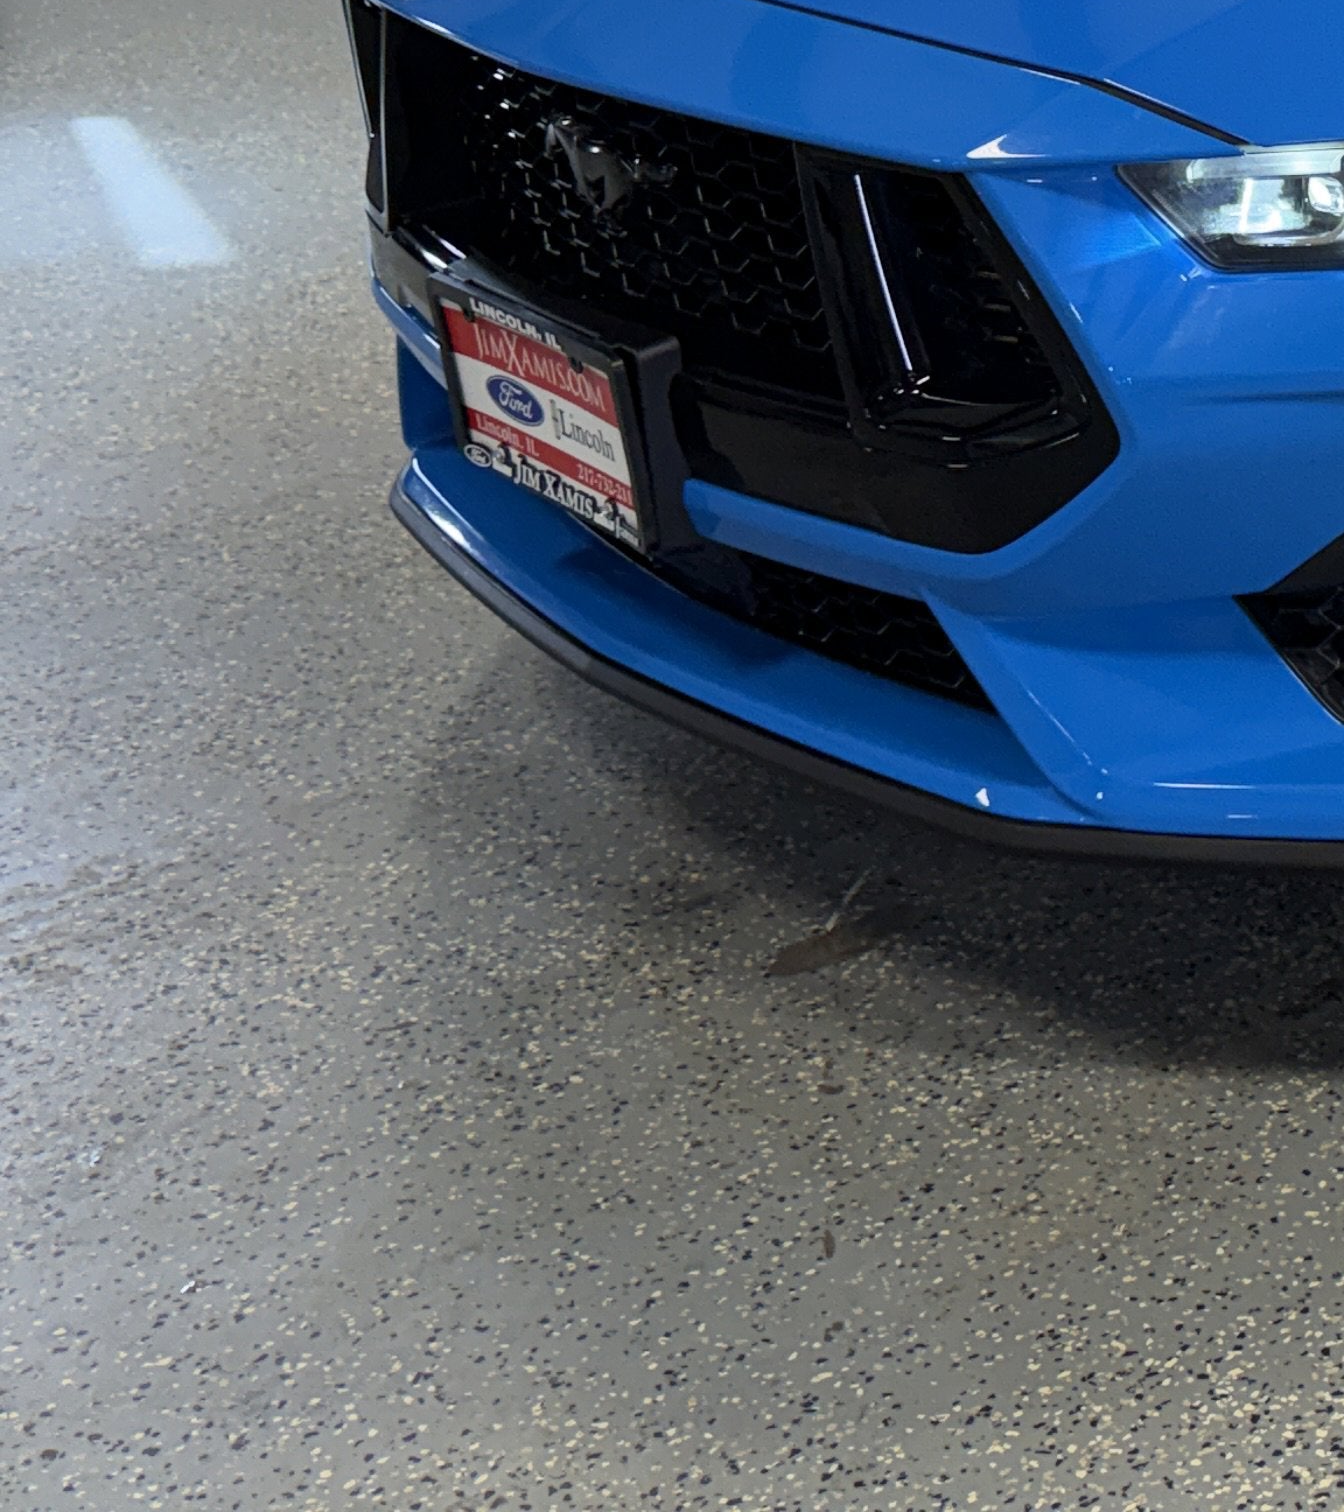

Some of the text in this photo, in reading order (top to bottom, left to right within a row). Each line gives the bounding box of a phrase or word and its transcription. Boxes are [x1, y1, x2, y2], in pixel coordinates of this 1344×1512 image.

[545, 332, 562, 351] IL
[499, 381, 533, 420] Ford
[558, 409, 615, 462] Lincoln
[513, 459, 595, 520] JIM XAMIS
